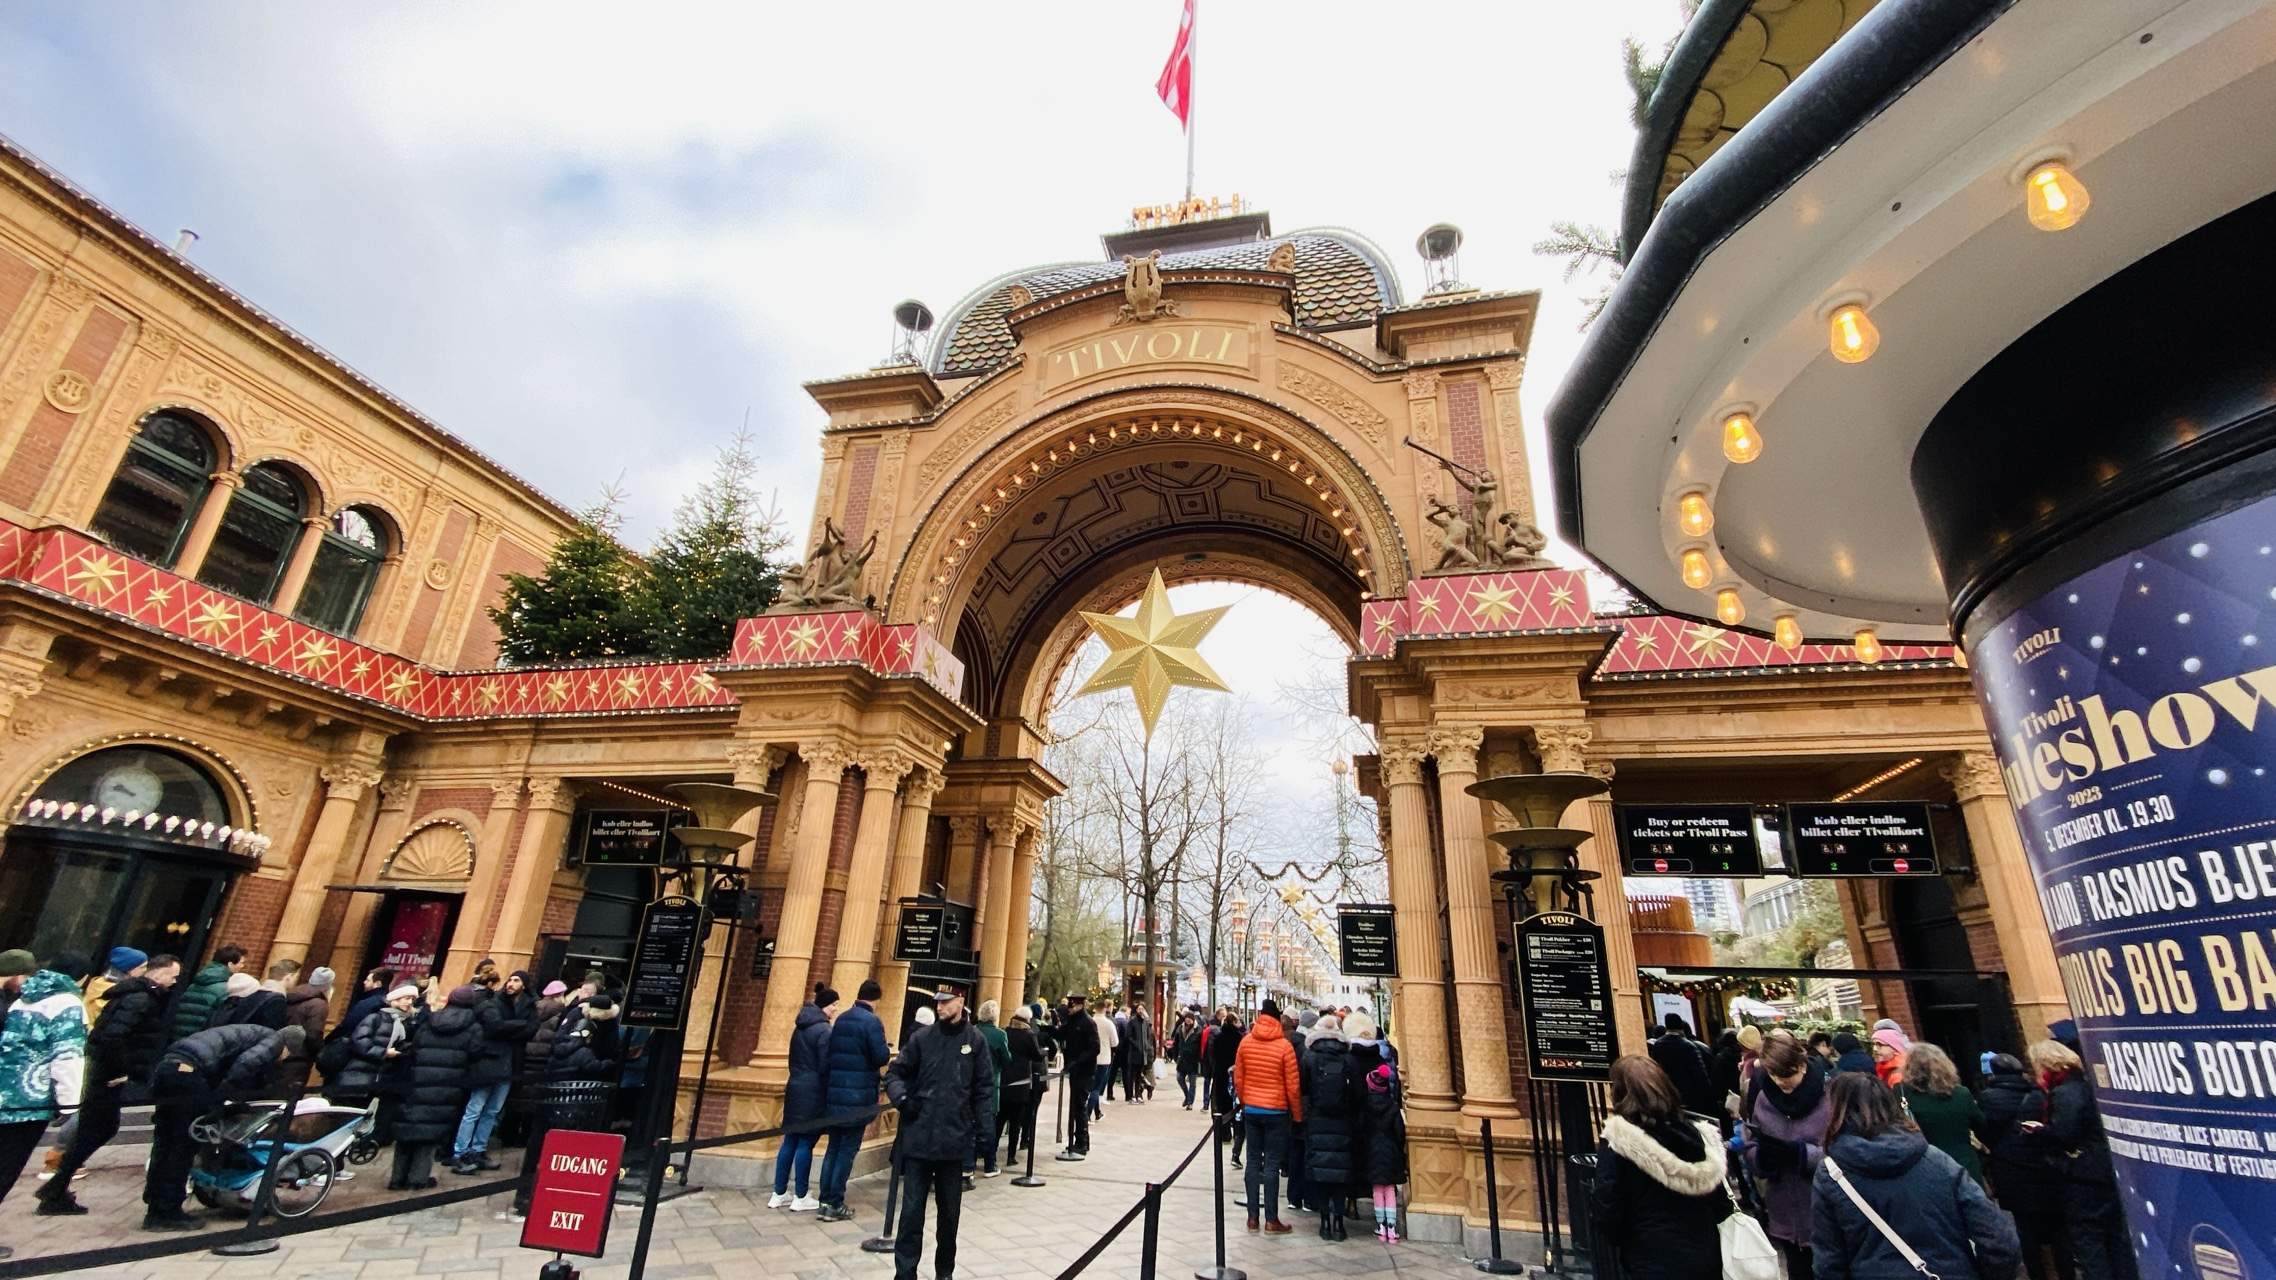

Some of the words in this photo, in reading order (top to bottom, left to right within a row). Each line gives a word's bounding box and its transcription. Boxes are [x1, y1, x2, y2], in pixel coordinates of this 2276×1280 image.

[1056, 328, 1233, 378] TIVOLI
[2012, 627, 2062, 665] TIVOLI
[2020, 695, 2077, 738] Tivoli
[2067, 786, 2103, 808] 2023
[1648, 817, 1669, 828] Buy
[1671, 819, 1685, 827] or
[1686, 817, 1730, 827] redeem
[1840, 815, 1868, 825] eller
[2052, 812, 2107, 850] DECEMBER
[2103, 807, 2129, 834] KL.
[2126, 794, 2175, 828] 19.30
[1632, 828, 1671, 838] tickets
[1672, 829, 1685, 838] or
[1686, 828, 1720, 838] Tivoli
[1721, 828, 1749, 838] Pass
[1800, 827, 1832, 837] billet
[1833, 827, 1862, 837] eller
[1862, 826, 1925, 837] Tivolikort
[1722, 862, 1729, 871] 3
[2082, 856, 2198, 921] RASMUS
[2199, 838, 2276, 904] BJE
[1540, 915, 1575, 926] TIVOLI
[2121, 938, 2198, 1016] BIG
[2200, 927, 2276, 1012] BA
[2102, 1041, 2194, 1095] RASMUS
[550, 1154, 608, 1176] UDGANG
[2213, 1153, 2227, 1174] AF
[550, 1211, 584, 1231] EXIT
